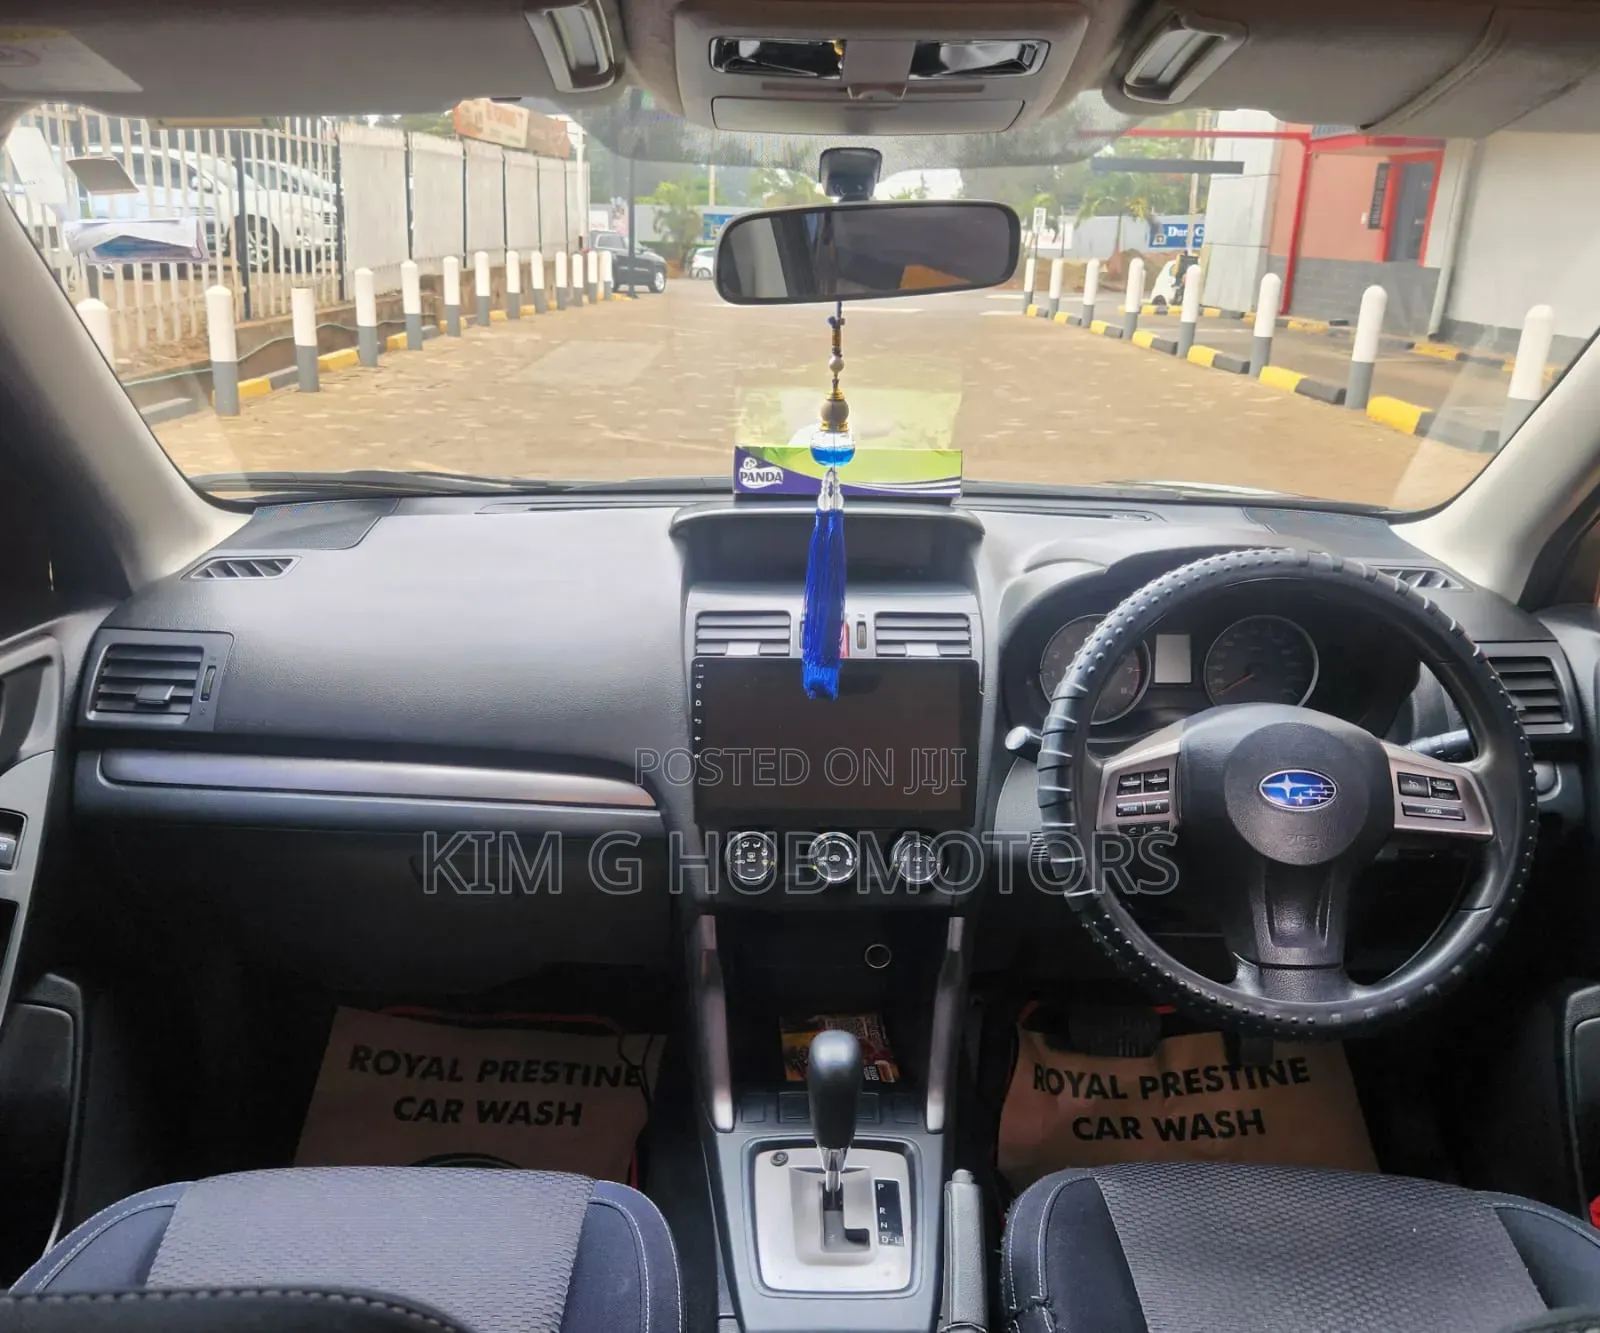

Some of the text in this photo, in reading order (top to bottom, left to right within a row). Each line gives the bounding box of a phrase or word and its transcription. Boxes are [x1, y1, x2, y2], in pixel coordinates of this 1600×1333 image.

[740, 471, 782, 482] PANDA
[347, 1044, 643, 1088] ROYAL PRESTINE
[1033, 1057, 1311, 1100] ROYAL PRESTINE
[393, 1096, 583, 1127] CAR WASH
[1072, 1109, 1266, 1142] CAR WASH
